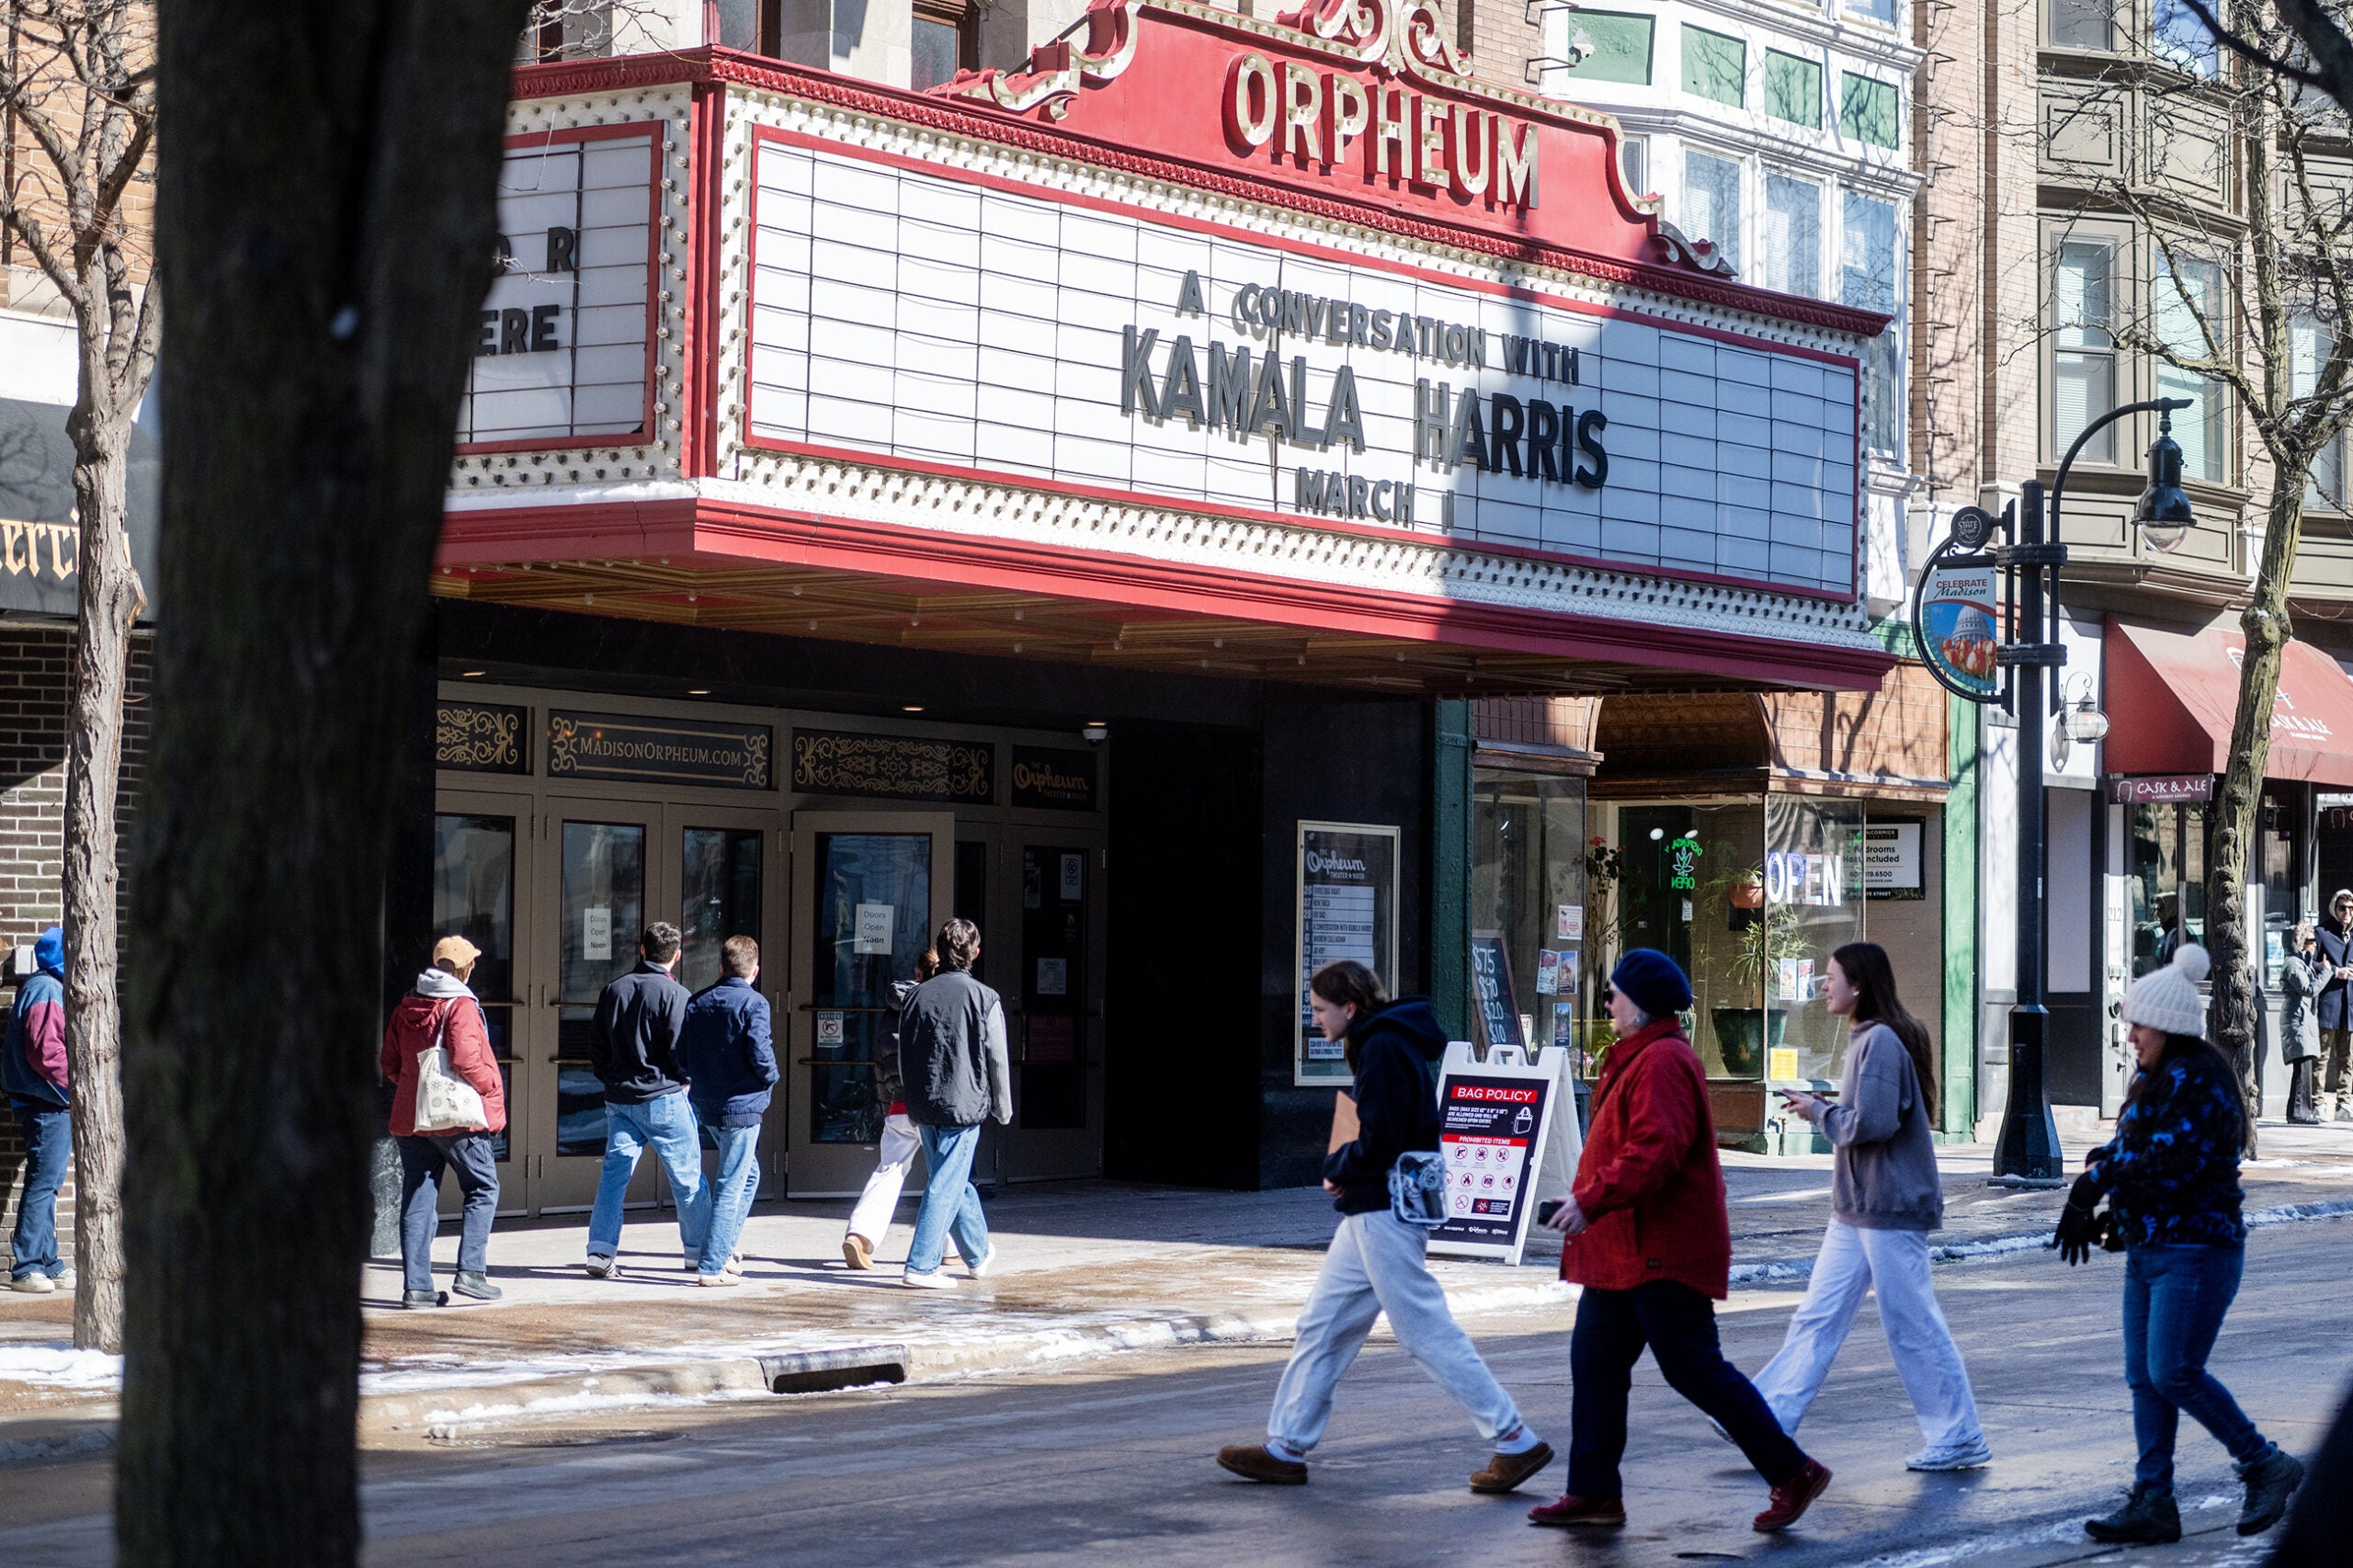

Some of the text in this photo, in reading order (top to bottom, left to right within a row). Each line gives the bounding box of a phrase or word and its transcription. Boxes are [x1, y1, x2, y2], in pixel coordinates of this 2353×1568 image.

[1225, 51, 1539, 210] ORPHEUM
[1178, 269, 1580, 386] A CONVERSATION WITH
[1121, 324, 1609, 490] KAMALA HARRIS
[1297, 466, 1415, 525] MARCH
[1934, 585, 1986, 599] Madison
[1936, 579, 1987, 588] CELEBRATE
[1013, 764, 1088, 793] Orpheum
[2137, 779, 2206, 794] CASK & ALE
[1307, 849, 1366, 875] Orpheum
[1767, 851, 1841, 906] OPEN
[1303, 886, 1313, 895] 26
[864, 910, 886, 919] Doors
[1304, 910, 1312, 919] 28
[2109, 907, 2122, 922] 212
[864, 923, 884, 931] Open
[863, 936, 884, 944] Noon
[1472, 943, 1496, 974] $75
[1478, 974, 1498, 1000] $40
[1483, 1001, 1504, 1021] $20
[1488, 1021, 1506, 1044] $10
[1458, 1087, 1532, 1101] BAG POLICY
